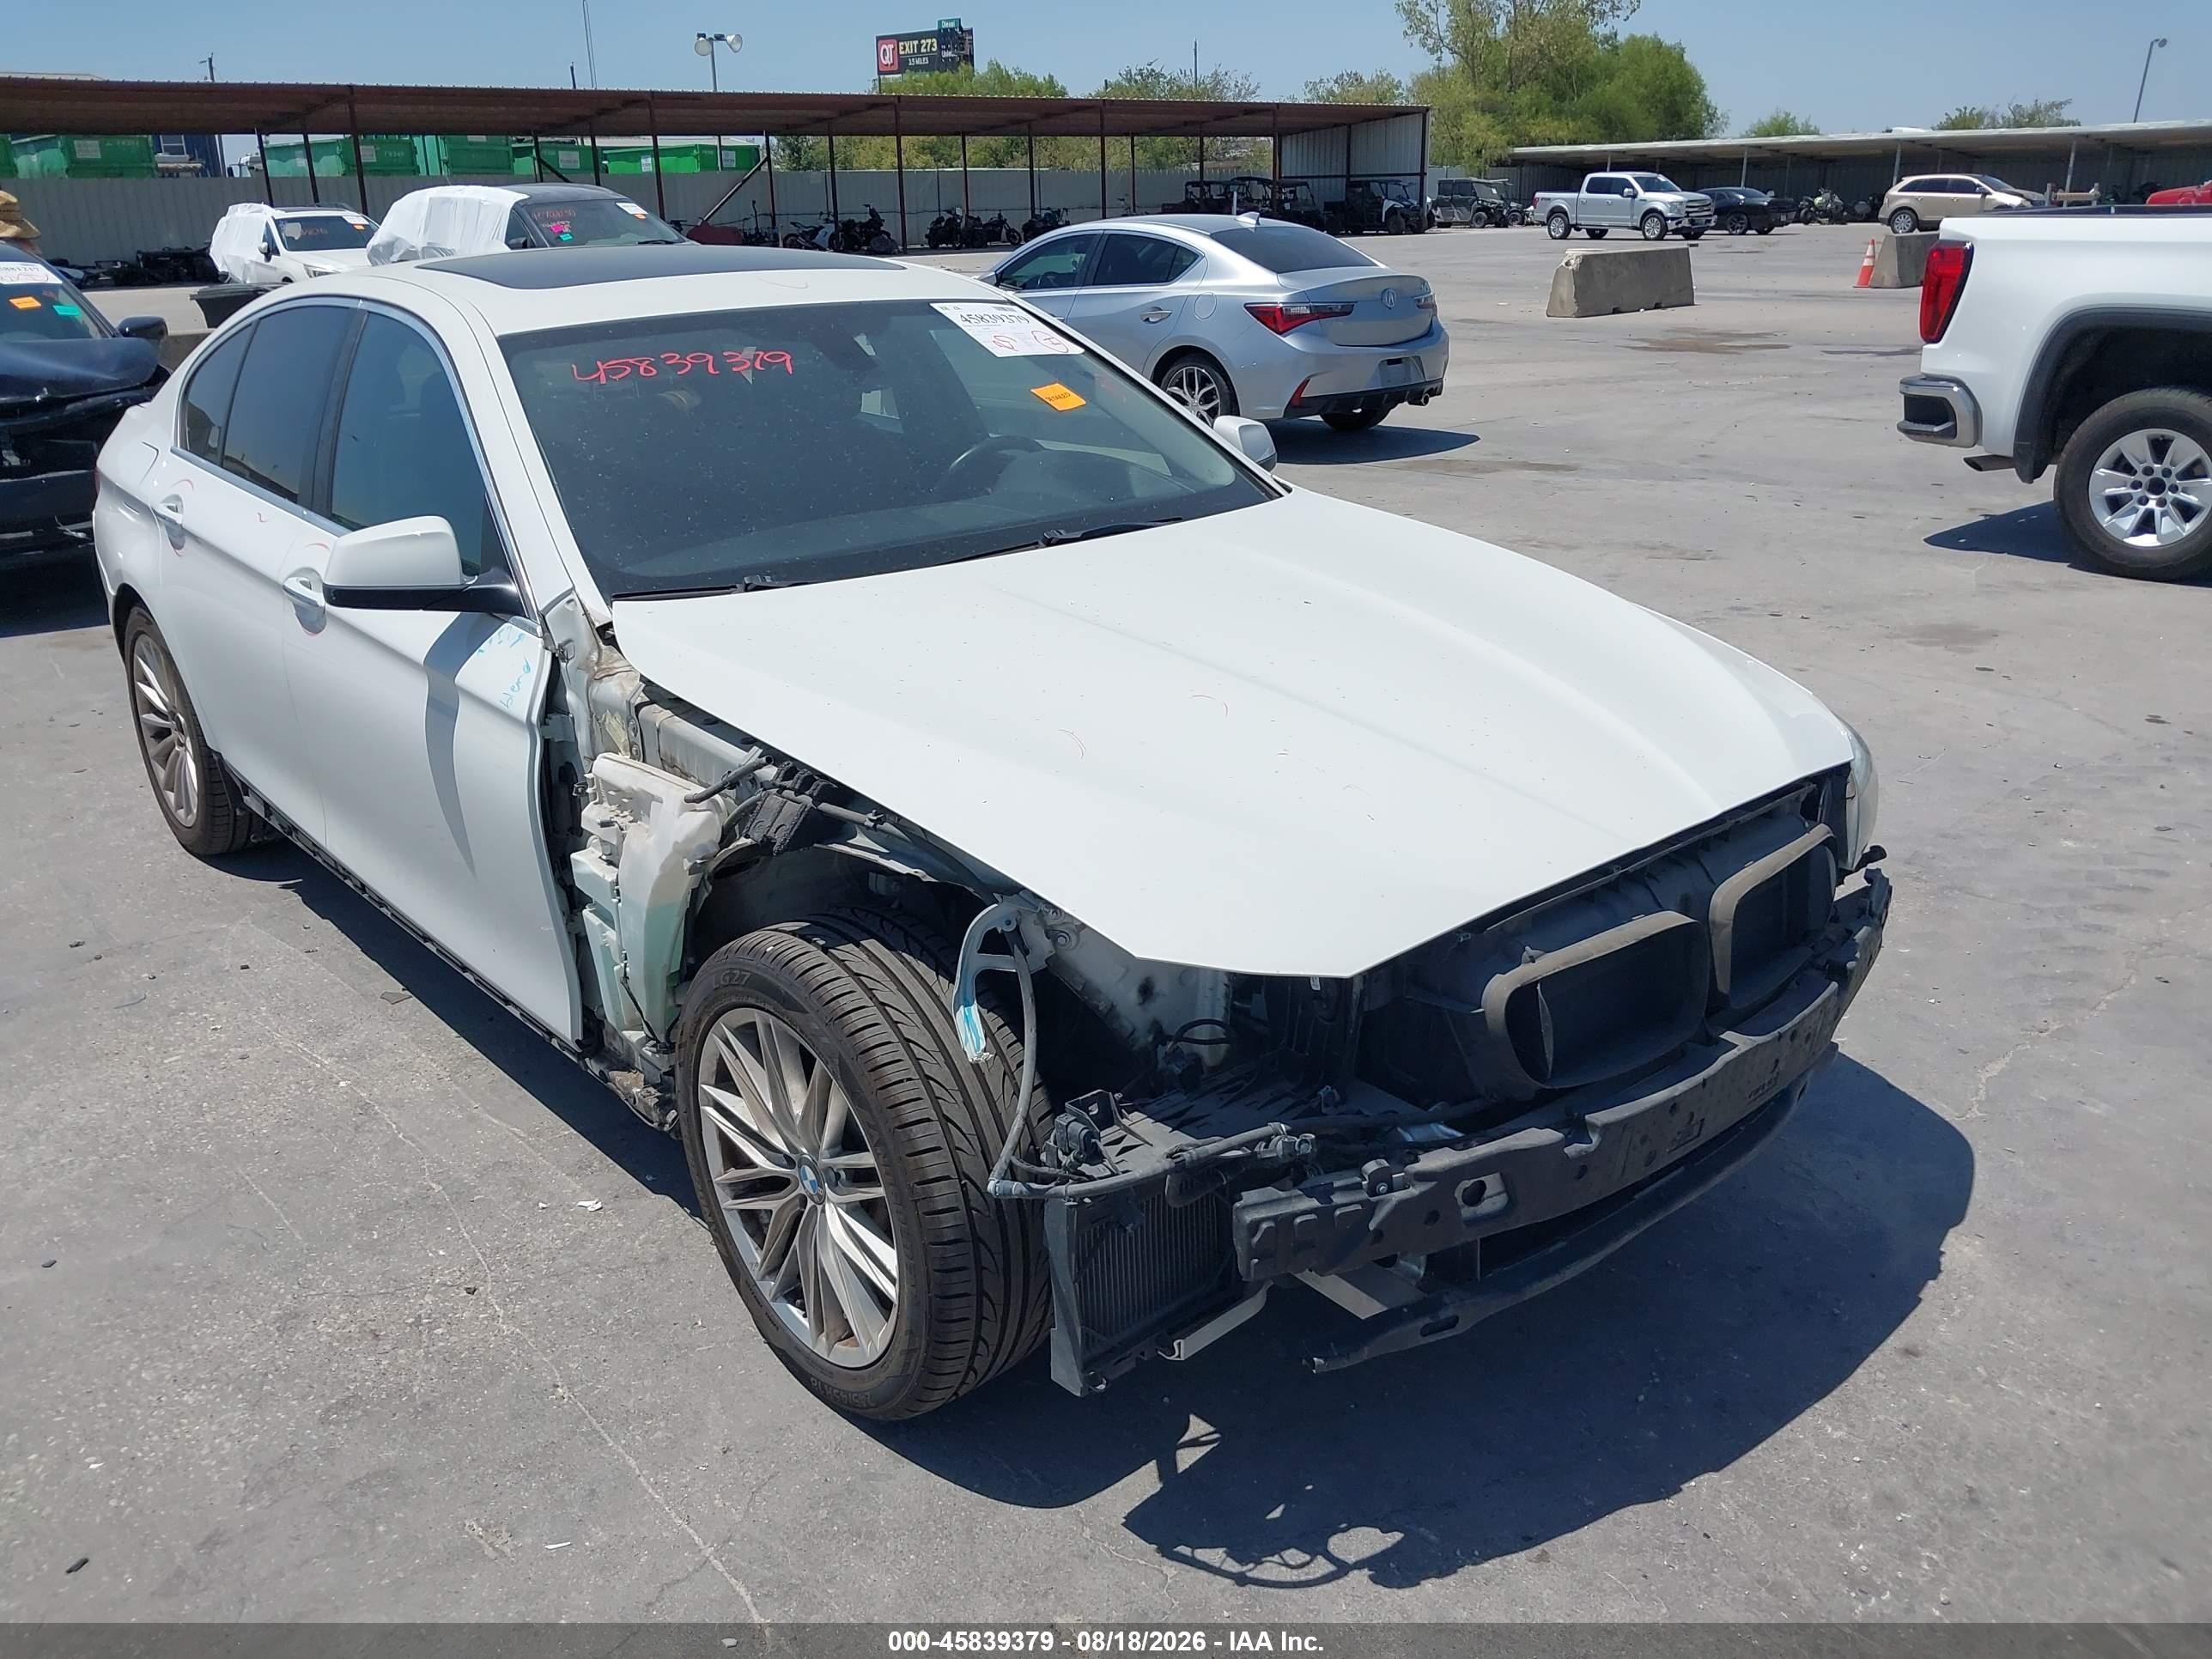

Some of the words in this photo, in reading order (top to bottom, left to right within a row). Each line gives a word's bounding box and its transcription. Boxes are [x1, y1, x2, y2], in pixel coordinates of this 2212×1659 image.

[898, 40, 919, 55] EXIT
[920, 38, 938, 53] 273
[880, 44, 894, 66] QT
[915, 57, 929, 65] MILES
[959, 313, 1030, 325] 45839379
